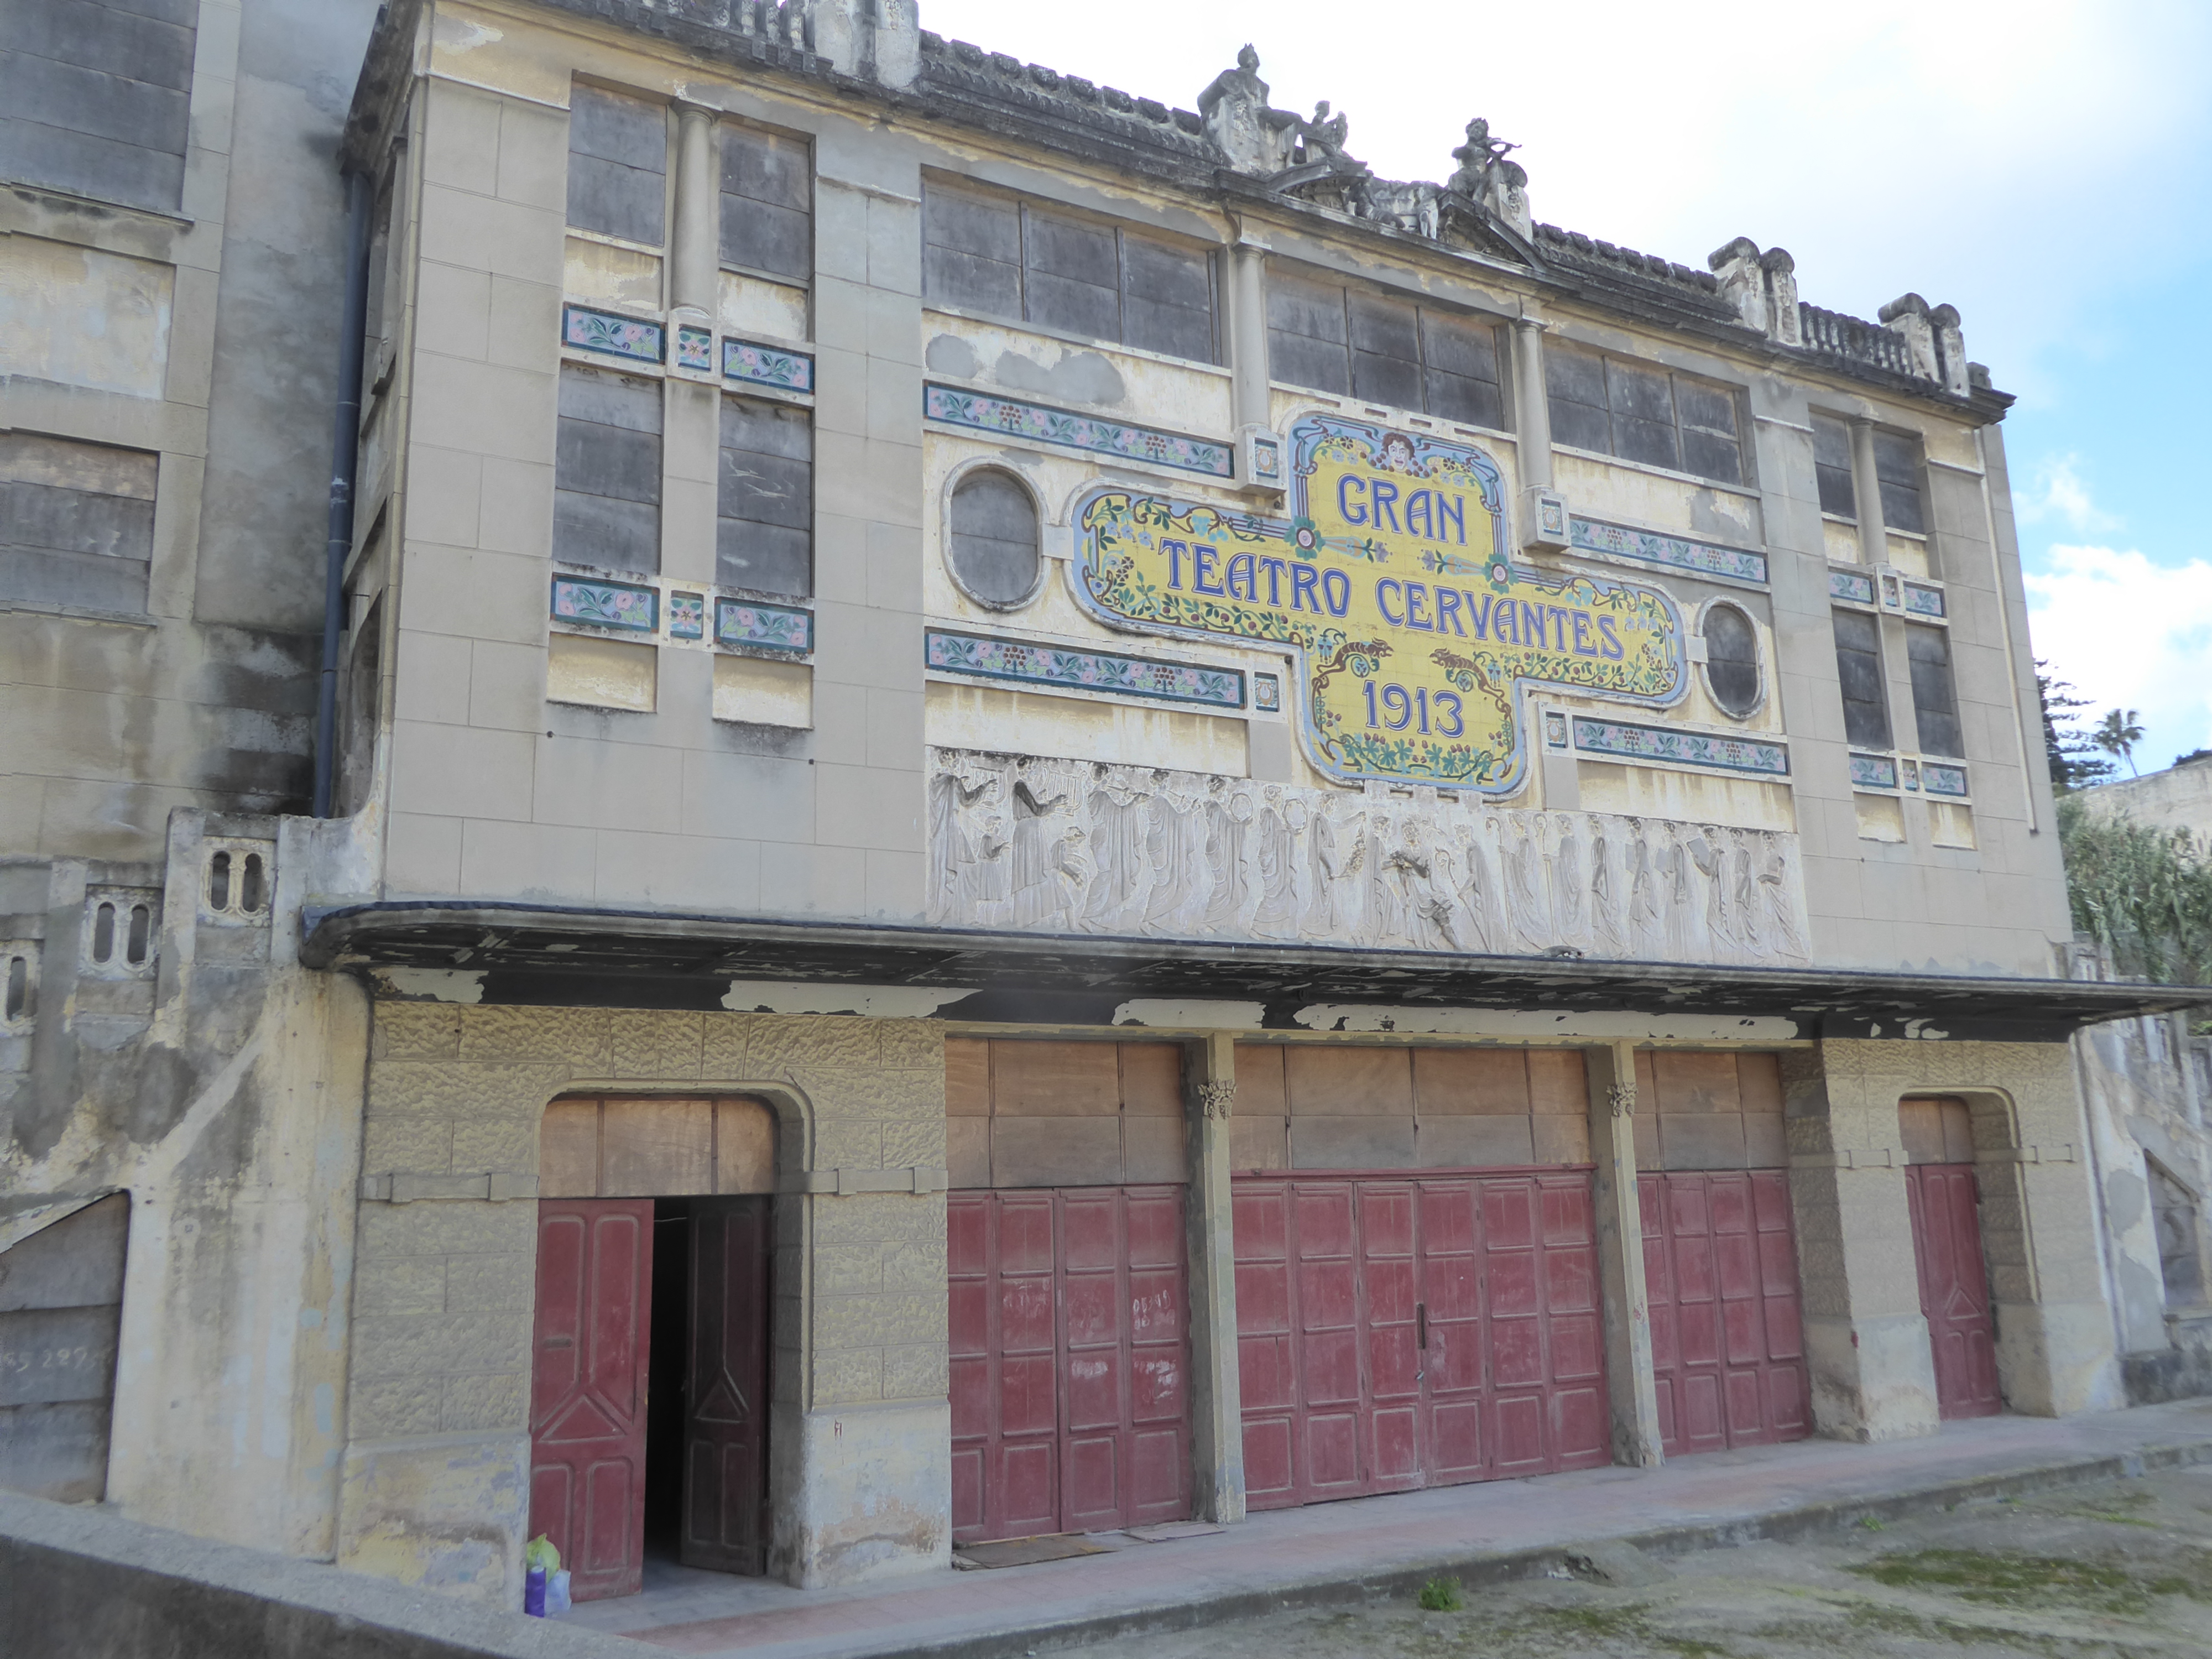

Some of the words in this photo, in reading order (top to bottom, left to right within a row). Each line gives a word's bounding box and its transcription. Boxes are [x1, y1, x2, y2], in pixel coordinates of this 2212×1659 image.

[1336, 473, 1467, 546] GRAN
[1158, 536, 1352, 618] TEATRO
[1375, 576, 1625, 660] CERVANTES
[1362, 680, 1464, 738] 1913
